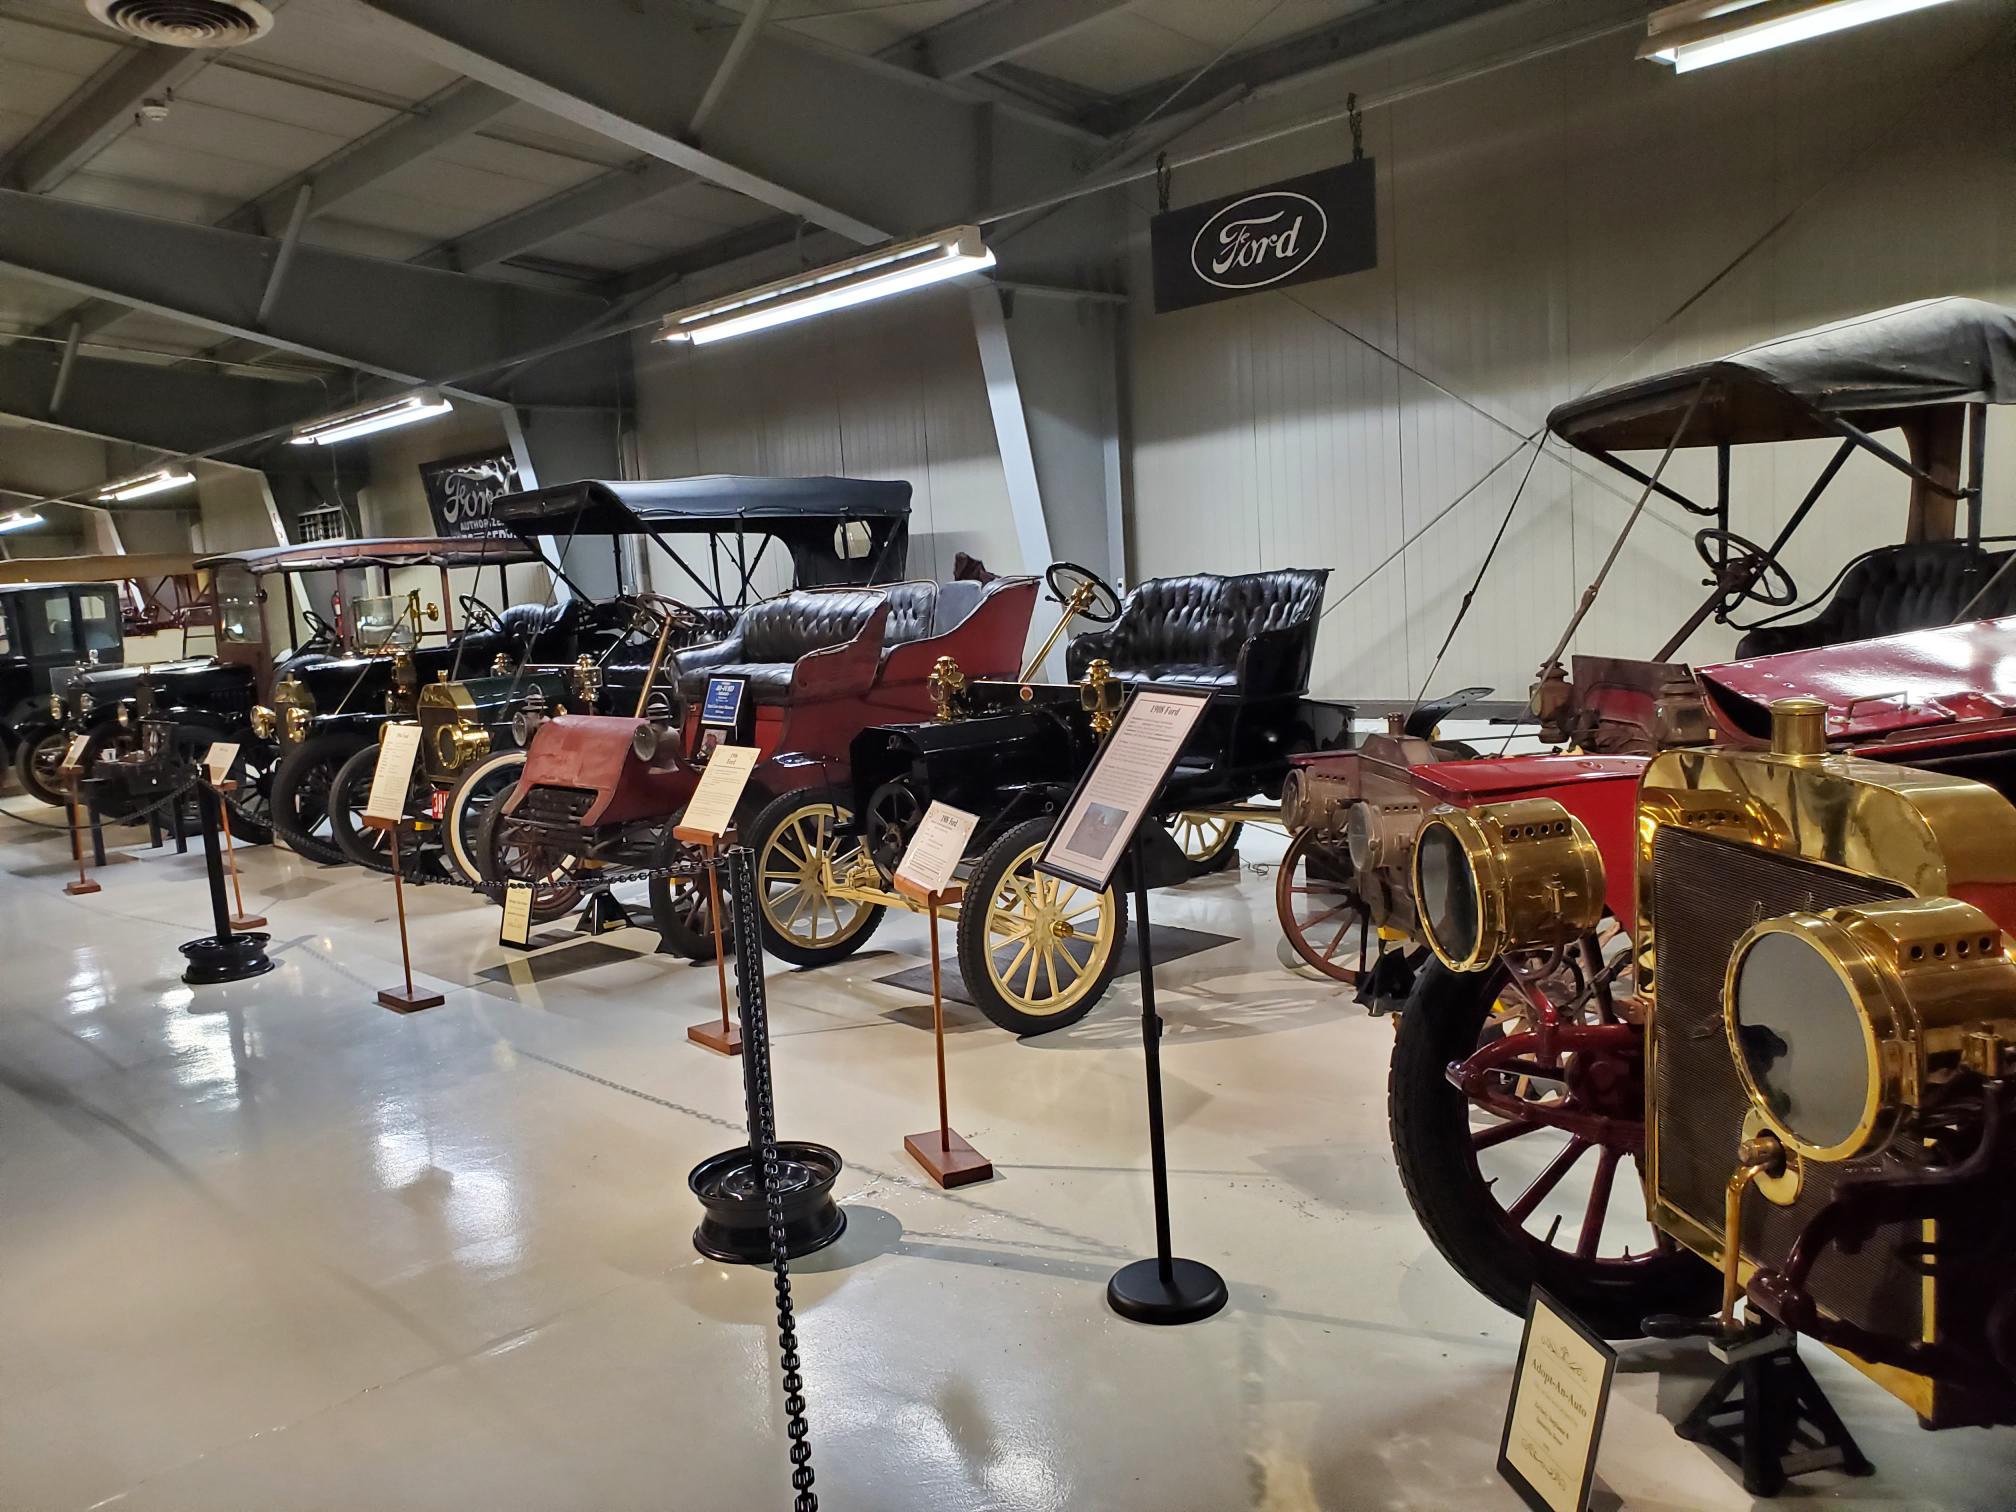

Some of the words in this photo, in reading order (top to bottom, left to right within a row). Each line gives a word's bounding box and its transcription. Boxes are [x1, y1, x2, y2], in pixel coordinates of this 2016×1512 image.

[1212, 210, 1303, 274] Ford
[1163, 706, 1181, 716] Ford
[1531, 1359, 1587, 1417] Adopt-An-Auto
